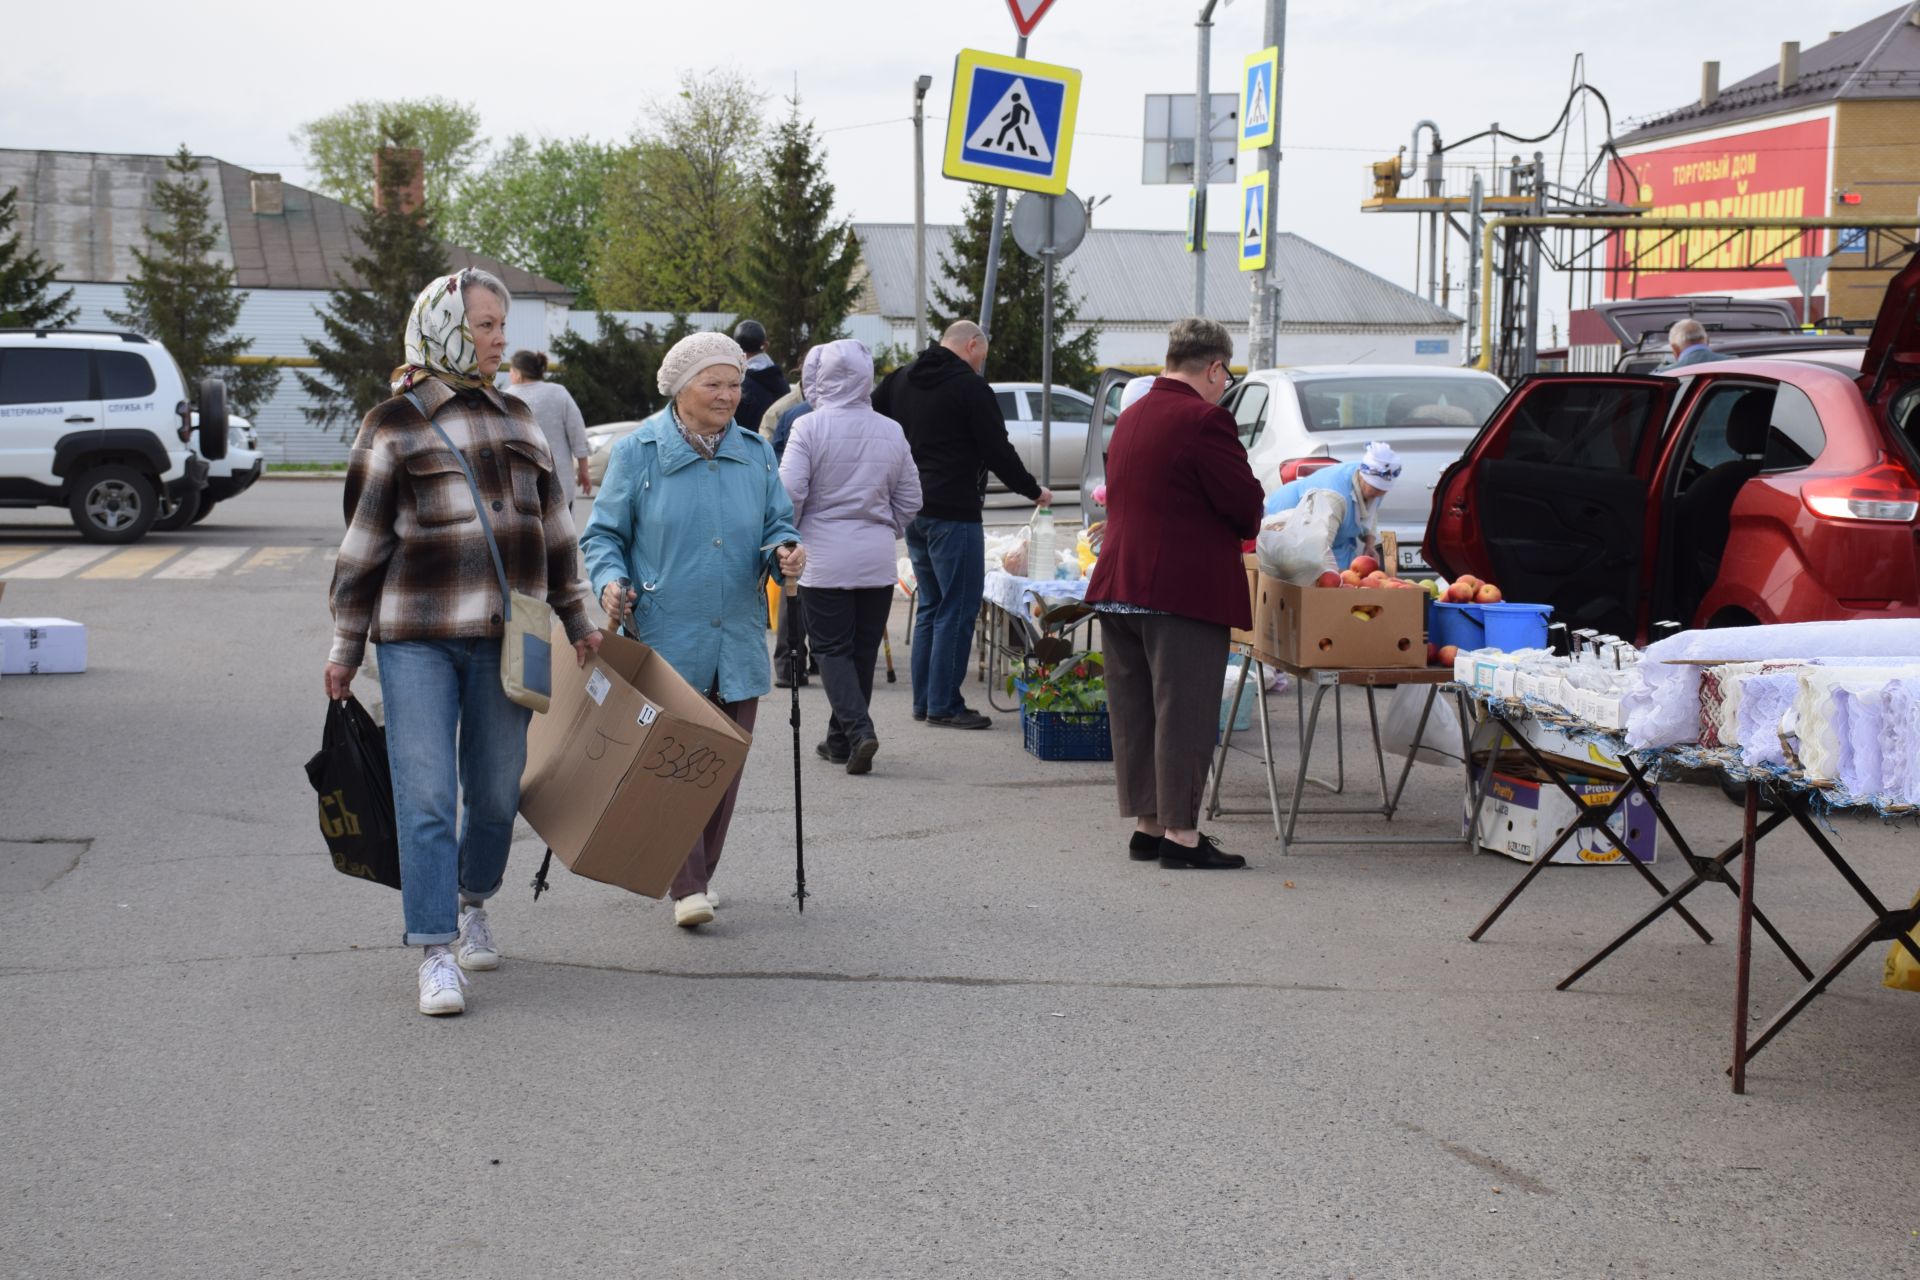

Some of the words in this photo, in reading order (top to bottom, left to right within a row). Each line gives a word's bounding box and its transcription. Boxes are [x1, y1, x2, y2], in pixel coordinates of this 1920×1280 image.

[1673, 154, 1729, 187] ТОРГОВЫЙ
[1731, 152, 1757, 181] ДОМ
[0, 406, 64, 417] ВЕТЕРИНАРНАЯ
[108, 403, 141, 413] СЛУЖБА
[144, 403, 155, 411] РТ
[1493, 782, 1515, 801] Pretty
[1584, 784, 1615, 794] Pretty
[1590, 794, 1610, 804] Liza
[1494, 800, 1509, 816] Liza
